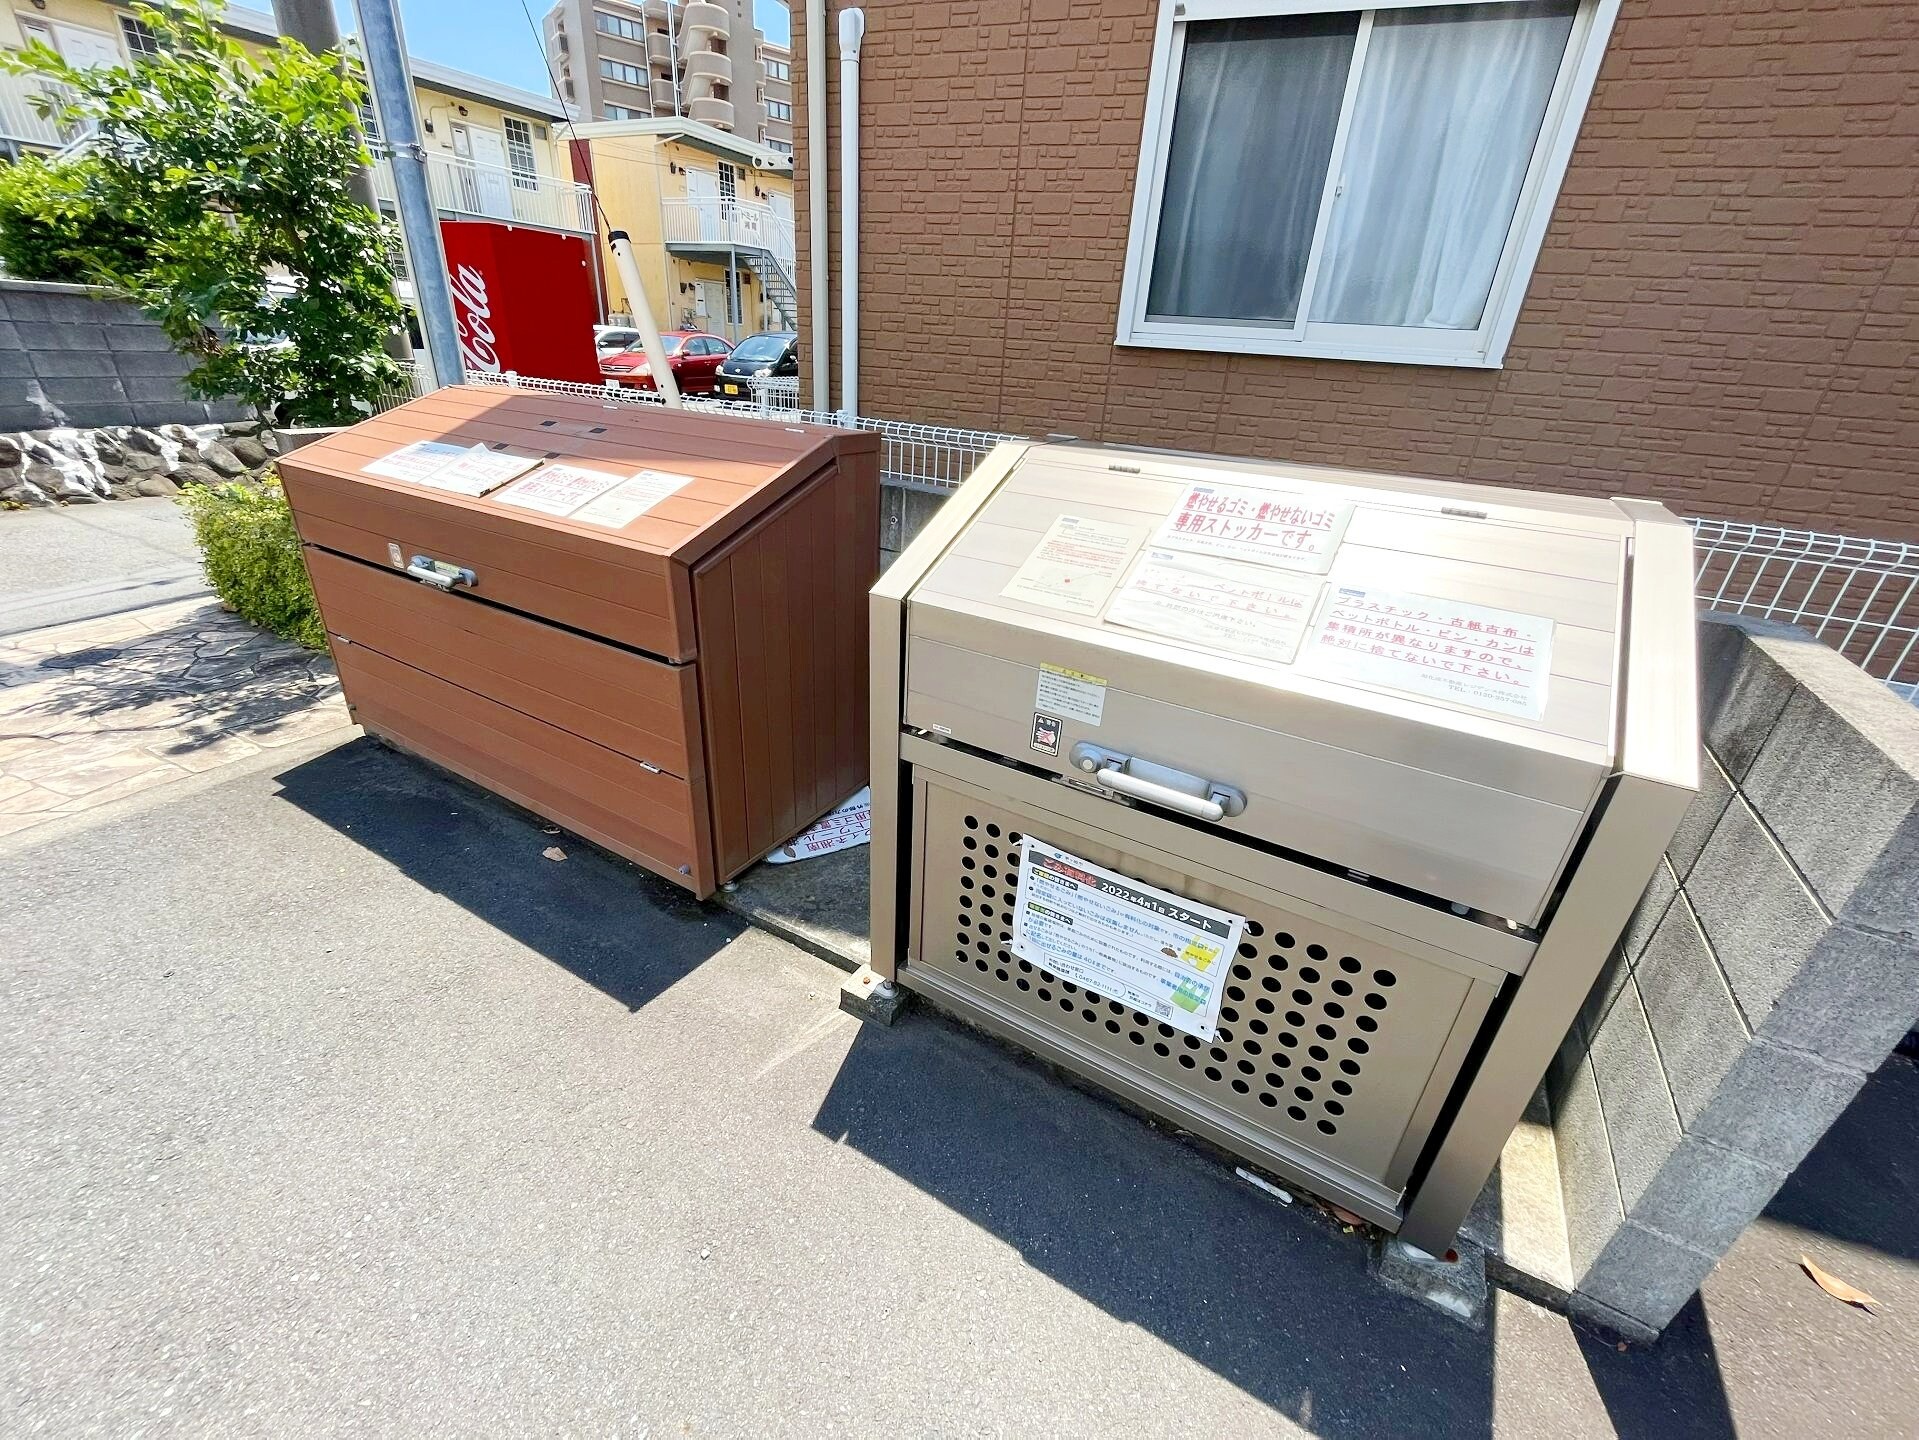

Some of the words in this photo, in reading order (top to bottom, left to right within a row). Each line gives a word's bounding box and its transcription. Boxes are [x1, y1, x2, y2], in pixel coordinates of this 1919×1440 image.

[1173, 511, 1317, 553] 専用ストッカーです。
[1323, 620, 1523, 671] 集積所が異なりますので、
[1330, 608, 1536, 657] ペットボトル・ビン・カンは
[1318, 633, 1523, 686] 絶対に捨てないで下さい。
[1168, 906, 1213, 932] スタート
